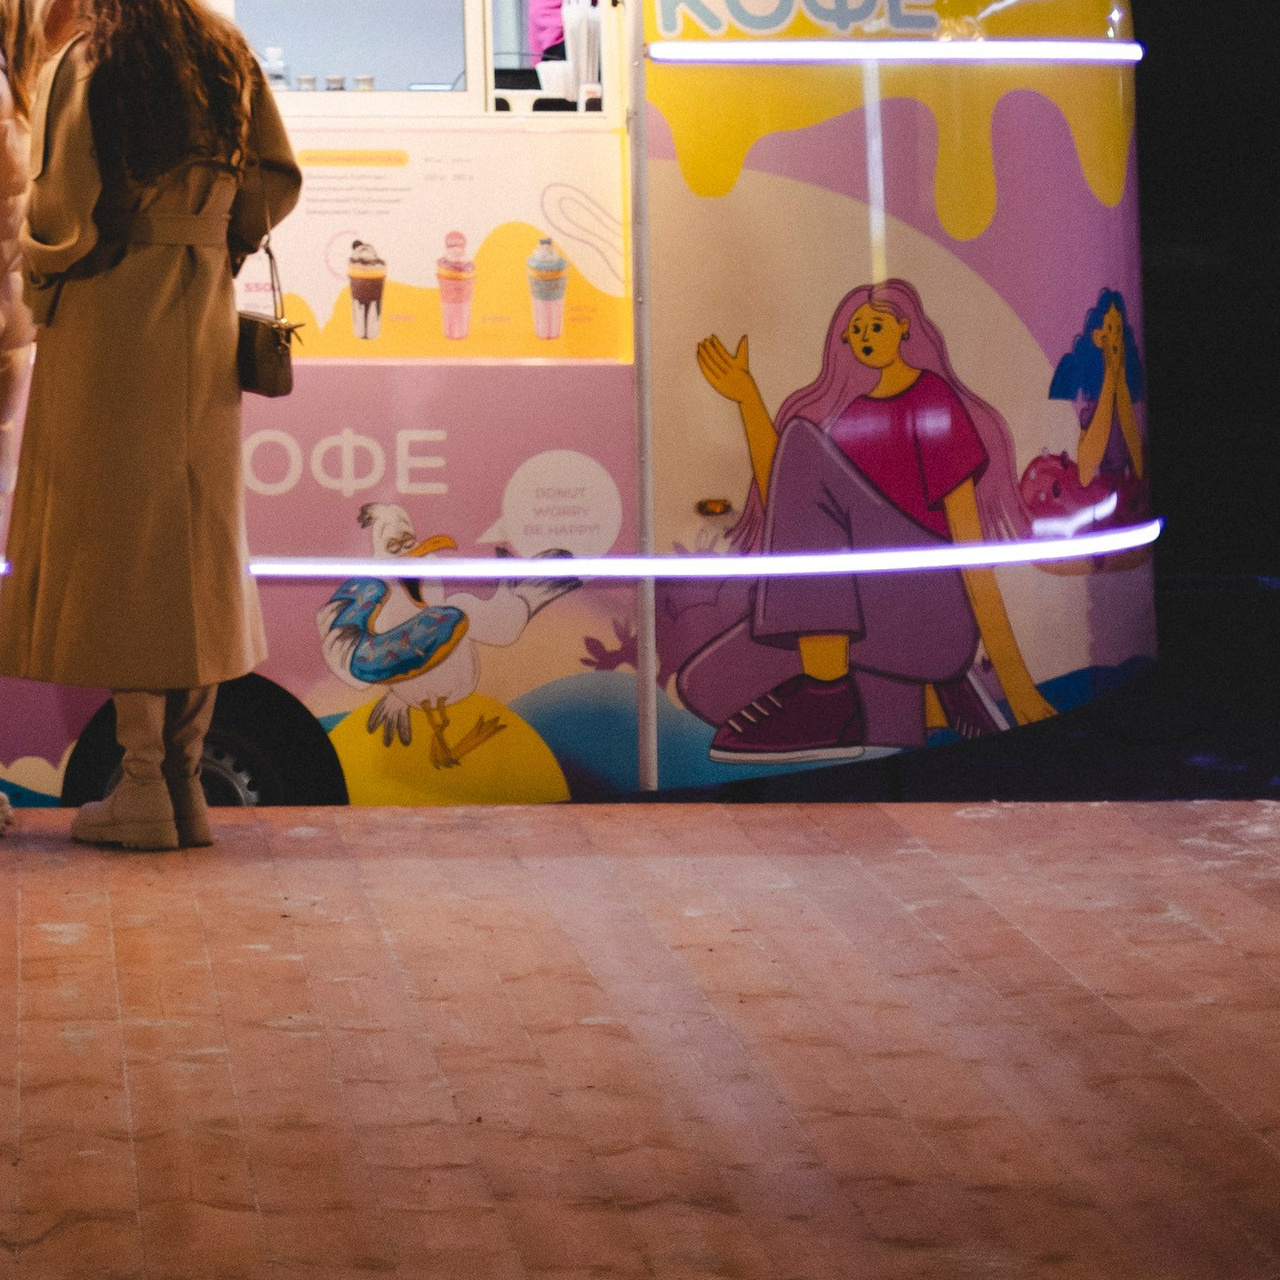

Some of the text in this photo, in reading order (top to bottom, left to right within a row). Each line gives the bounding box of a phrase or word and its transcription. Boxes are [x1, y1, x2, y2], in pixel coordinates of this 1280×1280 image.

[534, 487, 586, 499] DONUT
[533, 506, 589, 517] WORRY
[523, 524, 541, 536] BE
